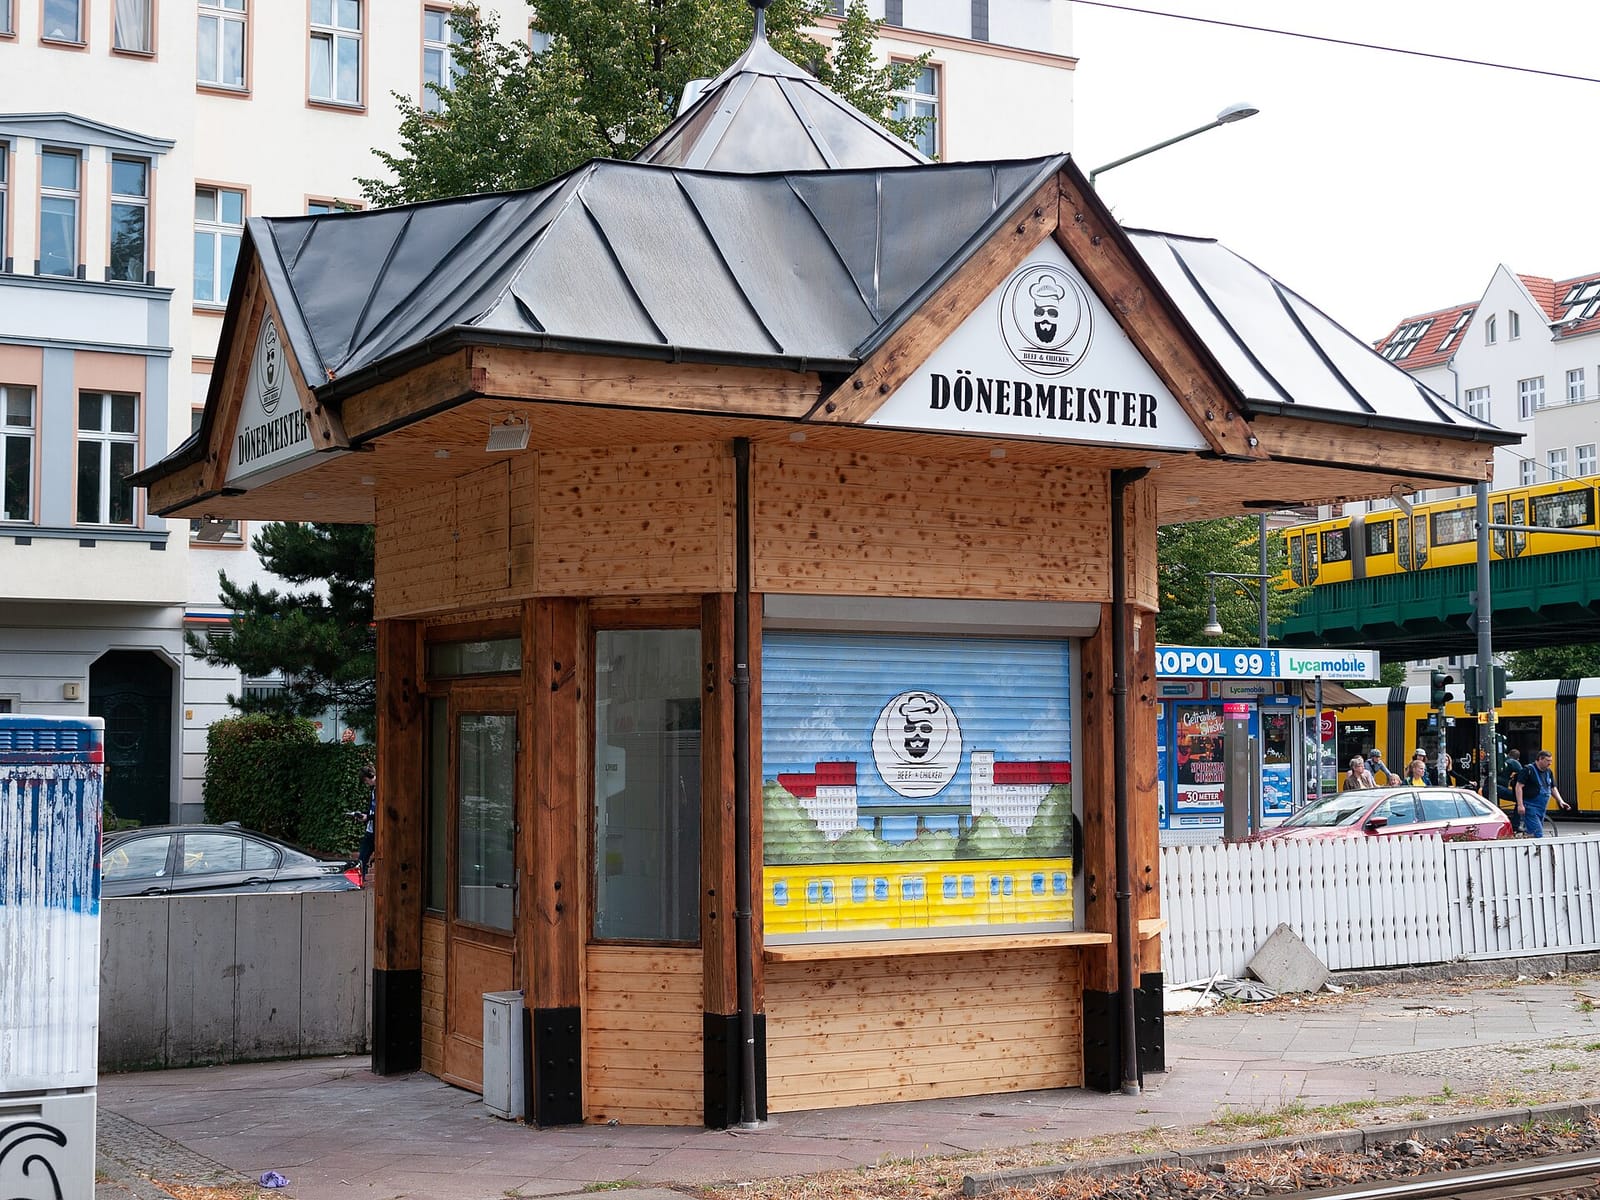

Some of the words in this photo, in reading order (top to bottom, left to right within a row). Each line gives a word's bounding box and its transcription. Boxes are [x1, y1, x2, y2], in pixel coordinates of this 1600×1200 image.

[1023, 352, 1037, 360] BEEF
[1045, 354, 1070, 363] CHICKEN
[929, 369, 1158, 429] DÖNERMEISTER
[1234, 653, 1263, 675] 99
[1289, 657, 1366, 674] Lycamobile
[1230, 686, 1265, 694] Lycamobile
[897, 770, 911, 779] BEEF
[1186, 791, 1198, 802] 30
